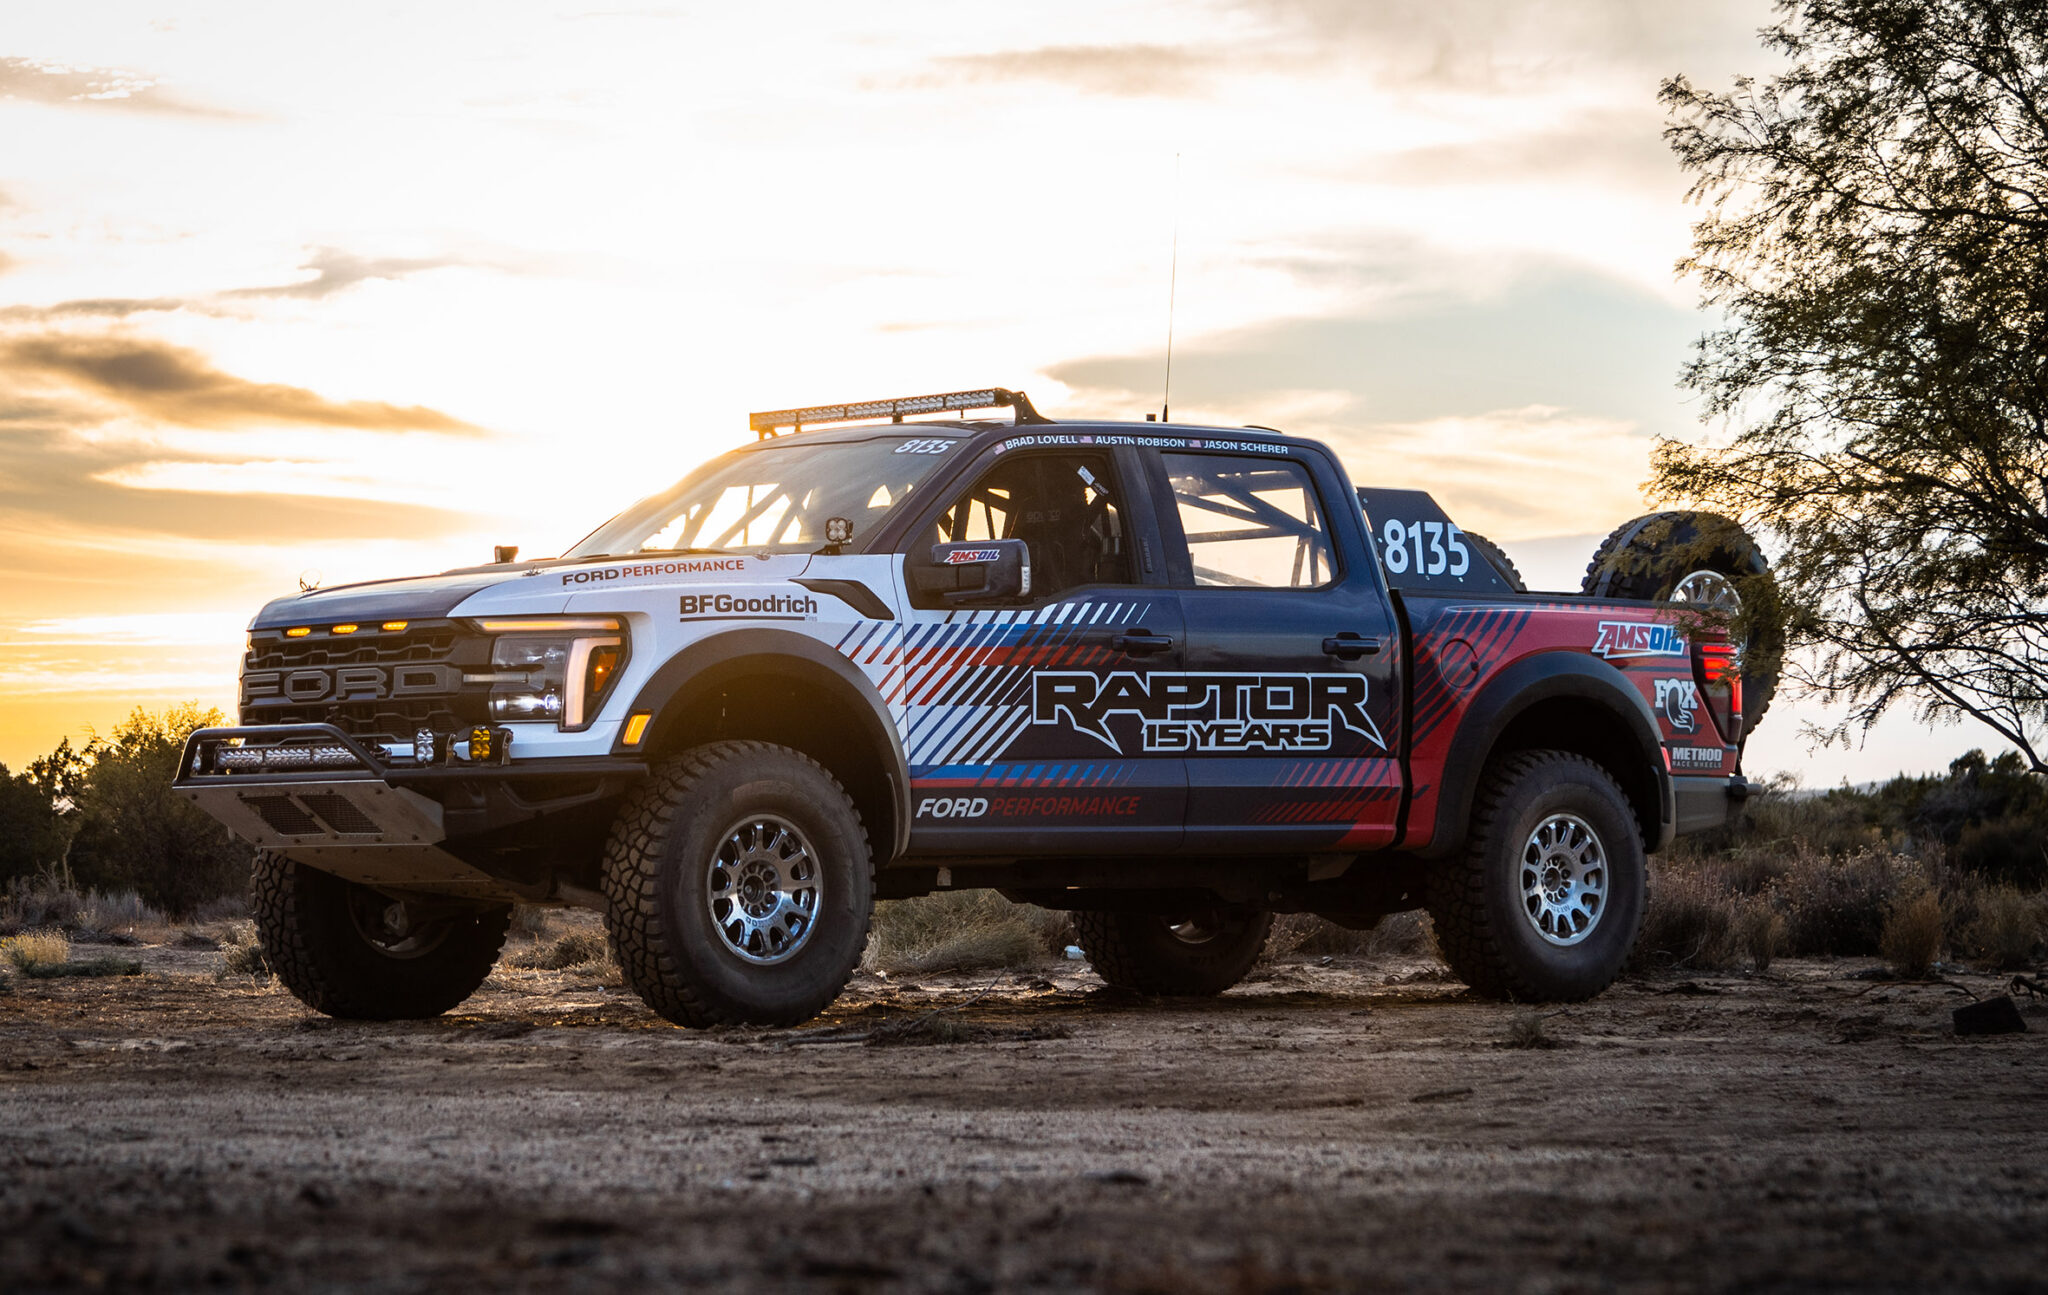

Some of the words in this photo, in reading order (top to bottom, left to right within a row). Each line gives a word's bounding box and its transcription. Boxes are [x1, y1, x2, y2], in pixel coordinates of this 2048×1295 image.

[894, 439, 958, 455] 8135
[1005, 435, 1035, 450] BRAD
[1037, 435, 1078, 444] LOVELL
[1095, 435, 1135, 445] AUSTIN
[1137, 437, 1186, 448] ROBISON
[1204, 440, 1238, 450] JASON
[1240, 442, 1289, 455] SCHERER
[945, 549, 999, 564] AMSOIL
[1383, 518, 1470, 576] 8135
[562, 568, 619, 586] FORD
[622, 559, 745, 578] PERFORMANCE
[679, 594, 818, 615] BFGoodrich
[1592, 621, 1685, 657] AMSOIL
[241, 664, 463, 706] FORD
[1654, 678, 1698, 722] FOX
[1033, 671, 1388, 755] RAPTOR
[1672, 747, 1723, 761] METHOD
[916, 797, 989, 818] FORD
[989, 796, 1141, 817] PERFORMANCE
